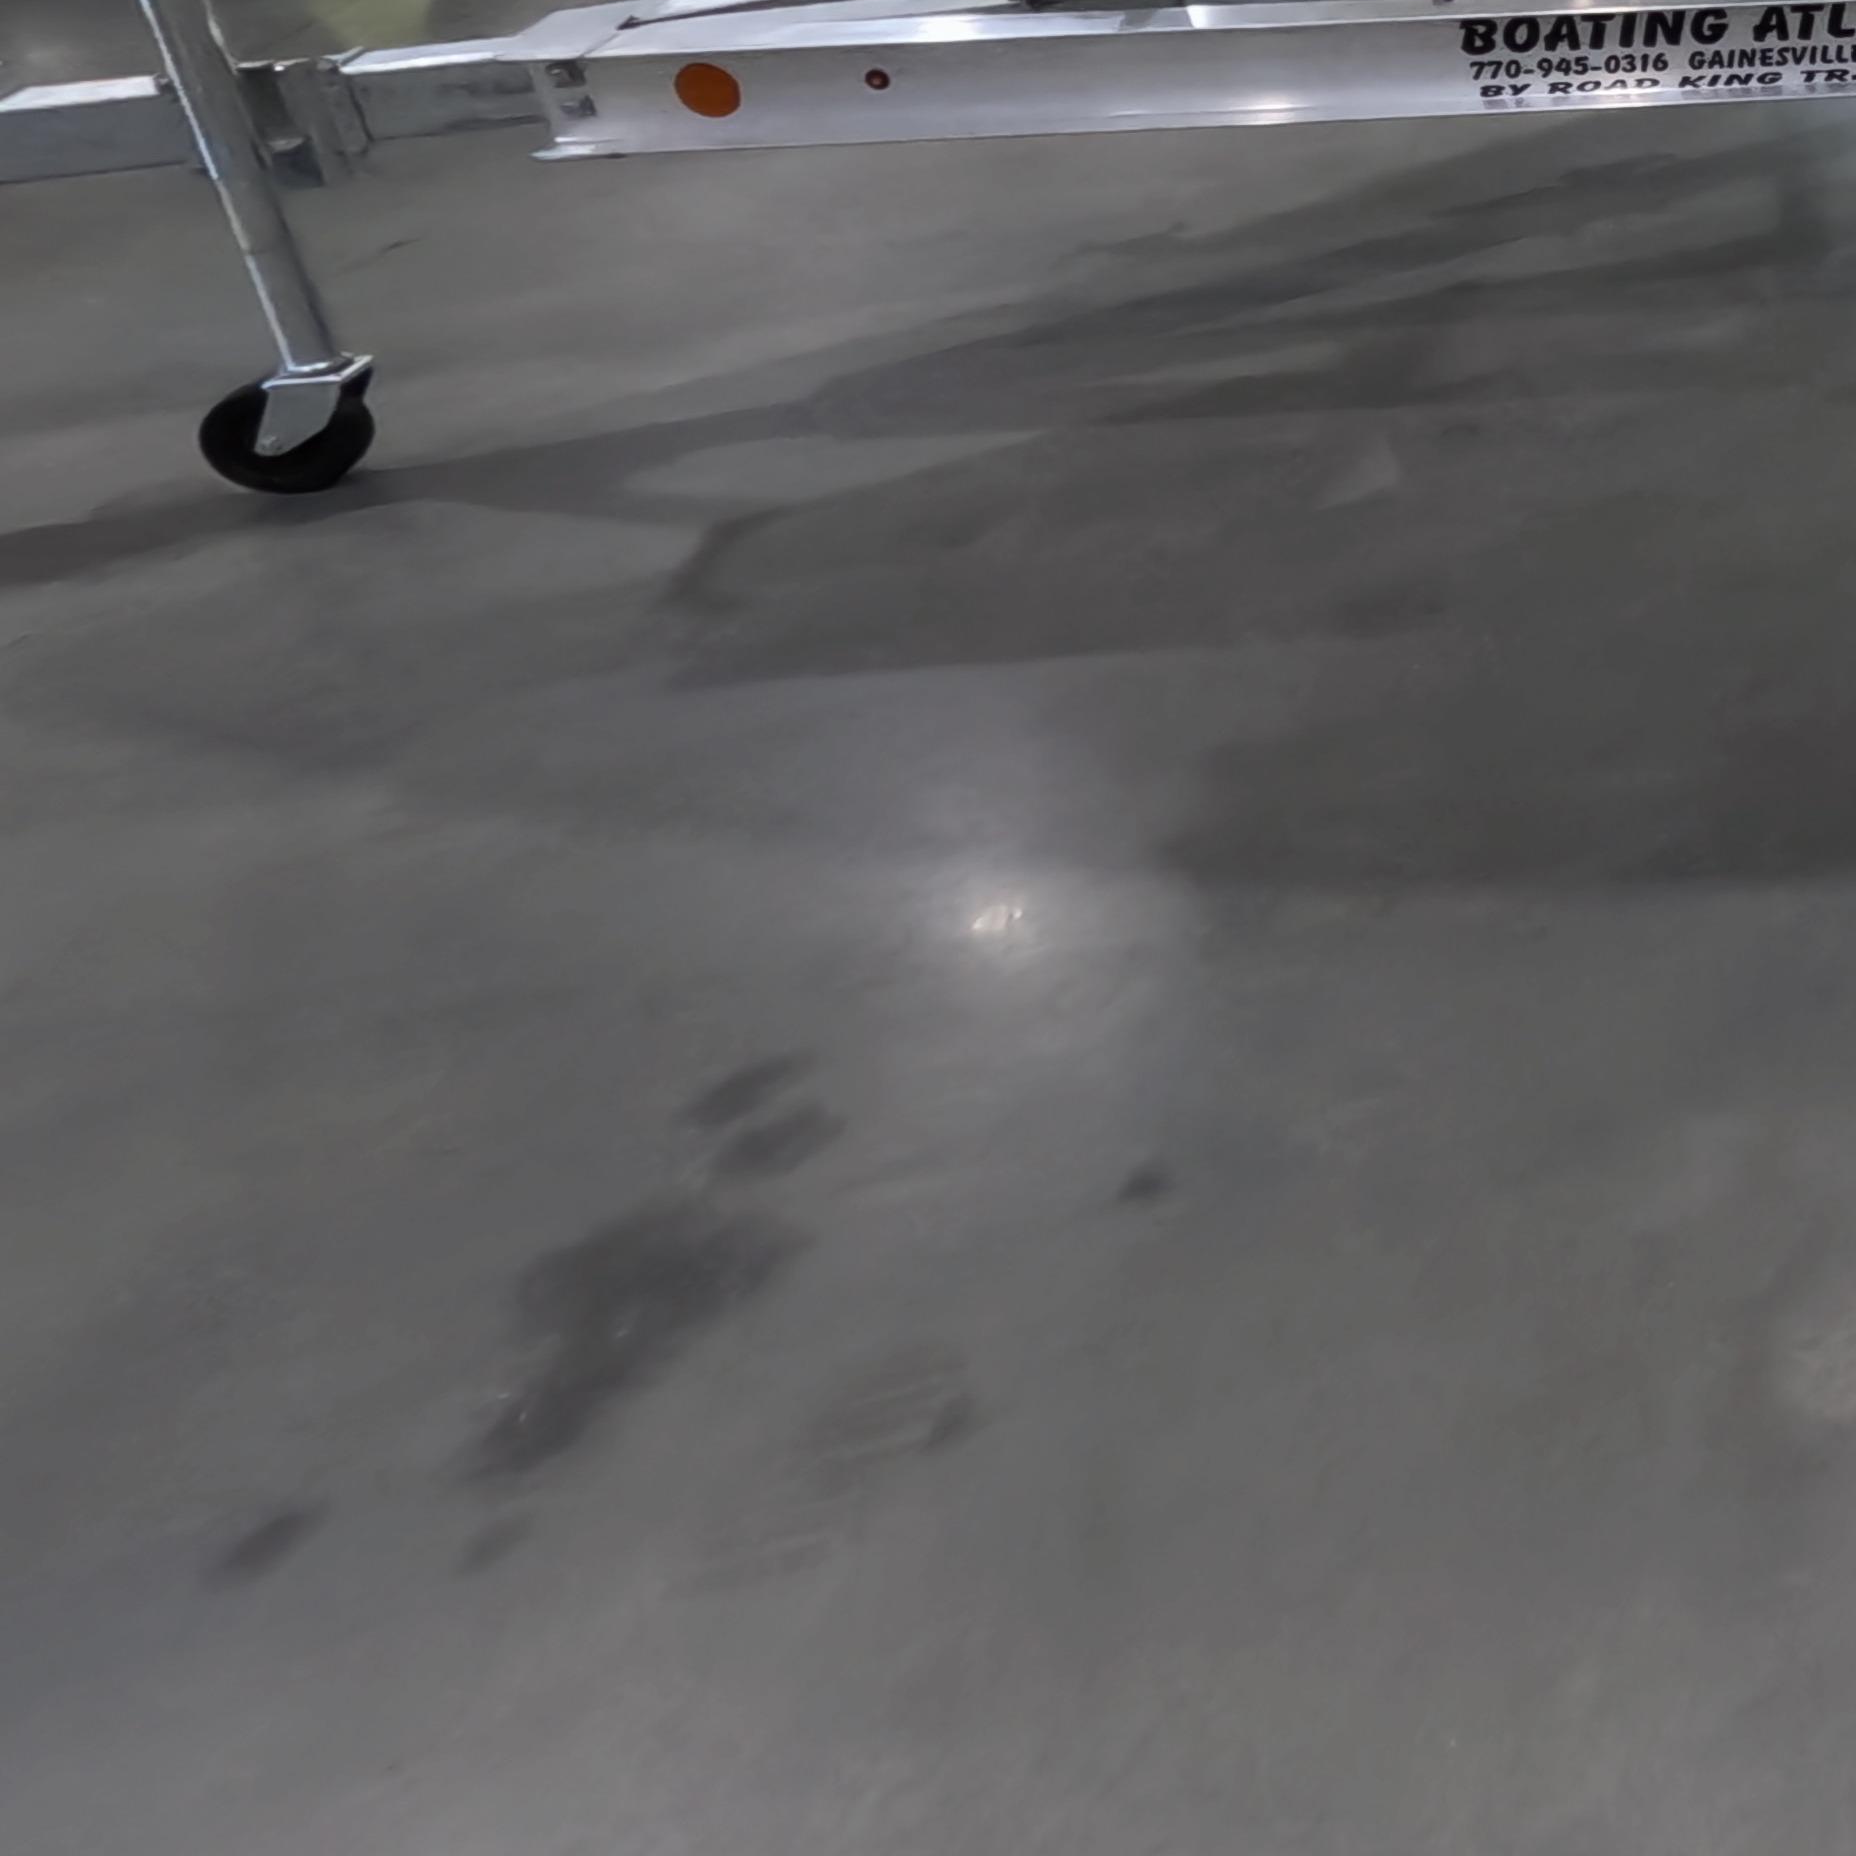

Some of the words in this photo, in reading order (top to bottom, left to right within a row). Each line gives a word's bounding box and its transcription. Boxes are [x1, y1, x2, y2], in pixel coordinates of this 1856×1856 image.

[1459, 8, 1729, 55] BOATING
[1470, 52, 1669, 80] 770-945-0316
[1479, 83, 1531, 98] BY
[1547, 78, 1660, 95] ROAD
[1678, 71, 1783, 89] KING
